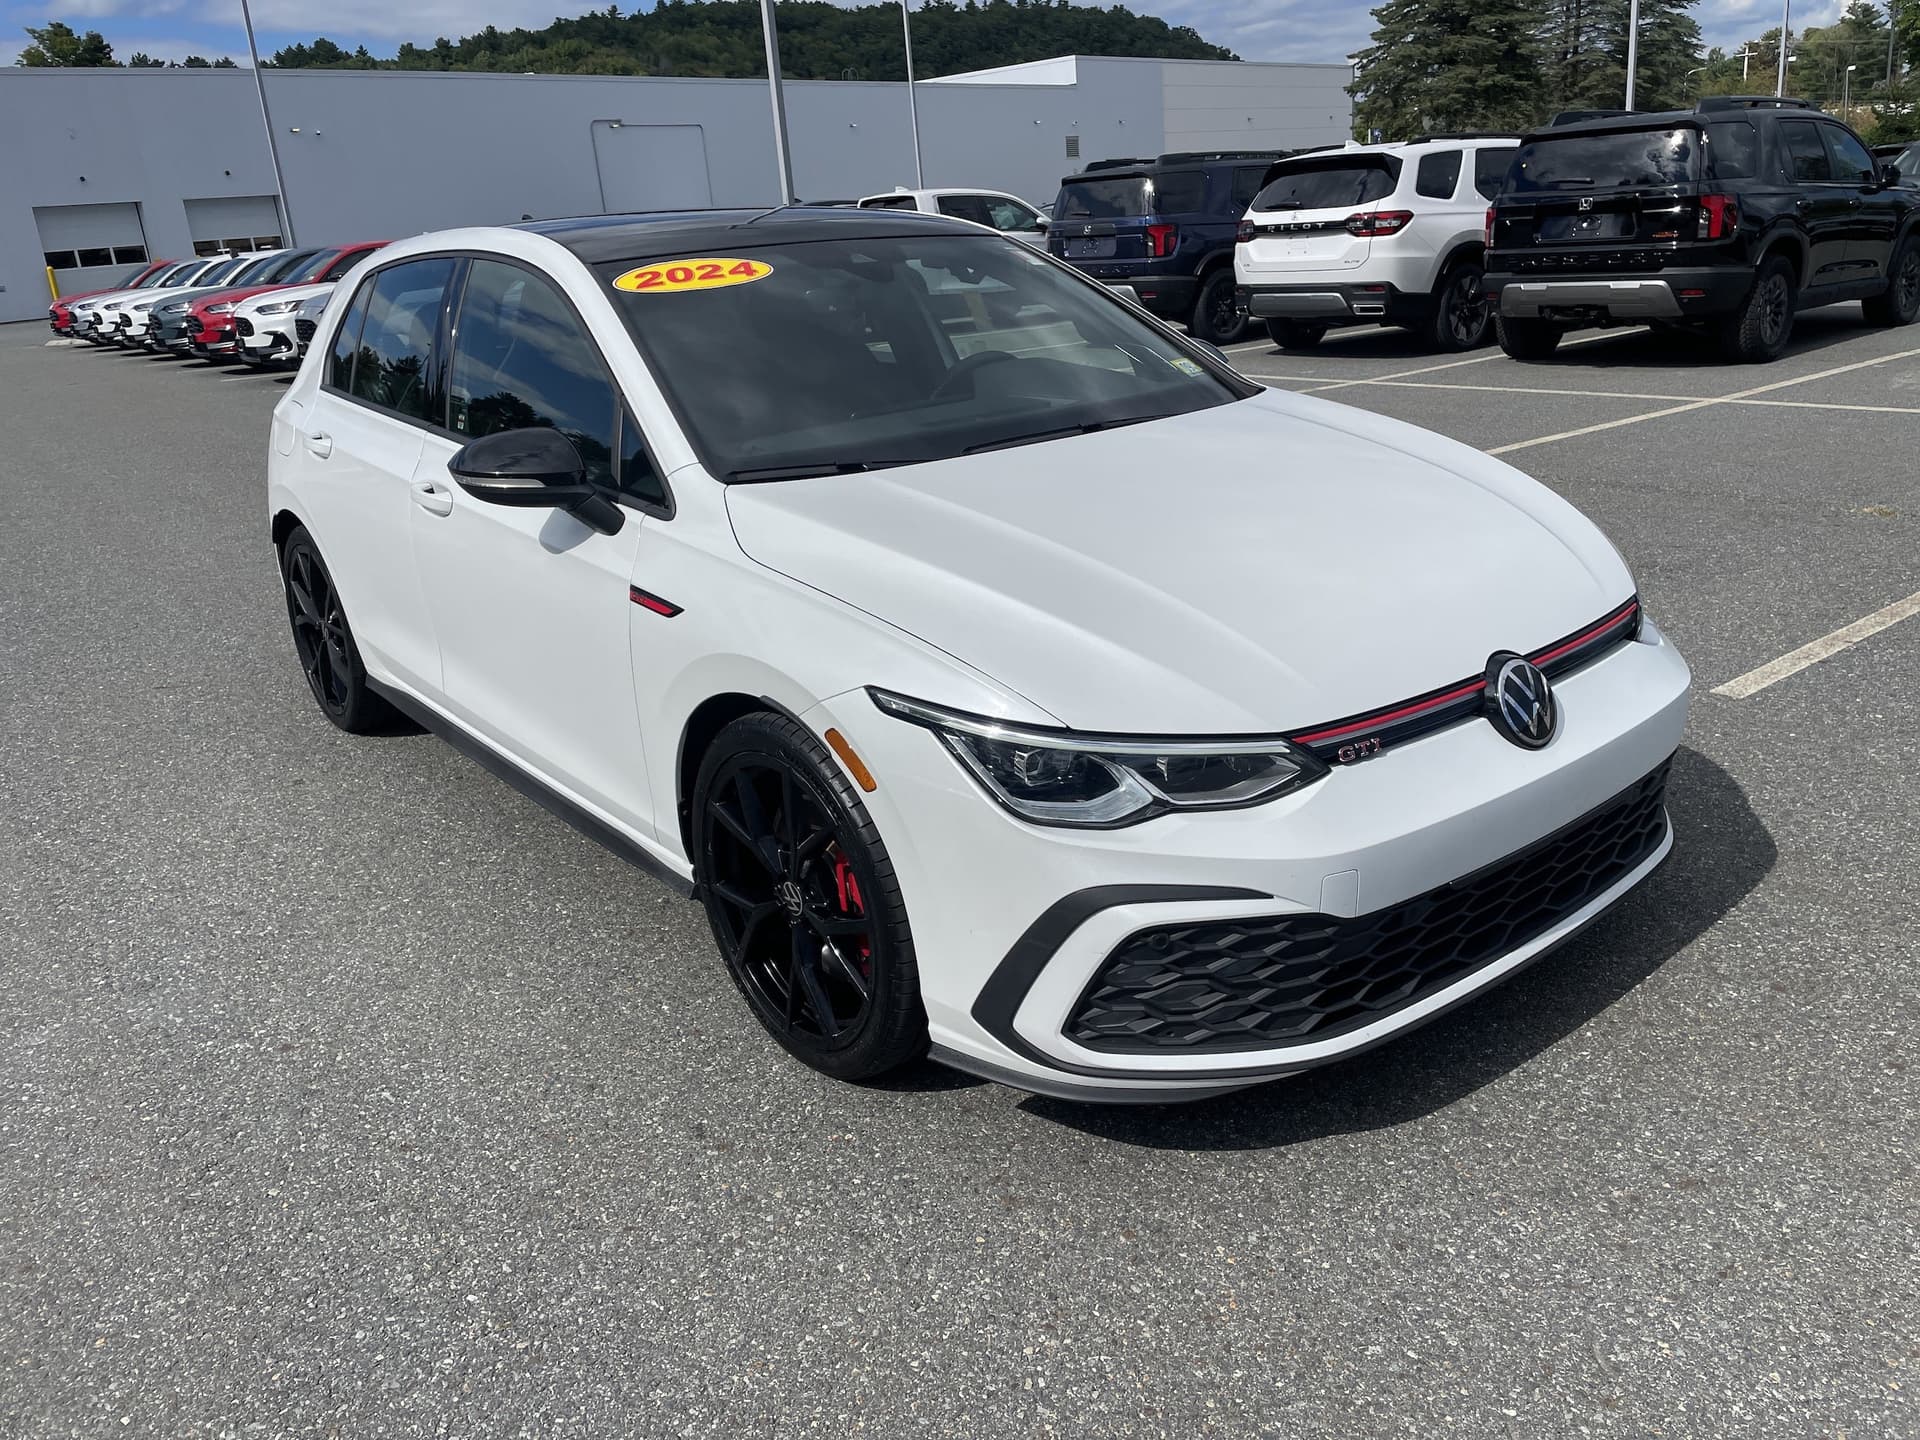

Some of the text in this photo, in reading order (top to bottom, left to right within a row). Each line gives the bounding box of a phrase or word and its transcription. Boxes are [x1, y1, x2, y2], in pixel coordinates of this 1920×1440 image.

[1267, 222, 1325, 233] PILOT
[634, 261, 760, 290] 2024
[1338, 737, 1382, 762] GTI
